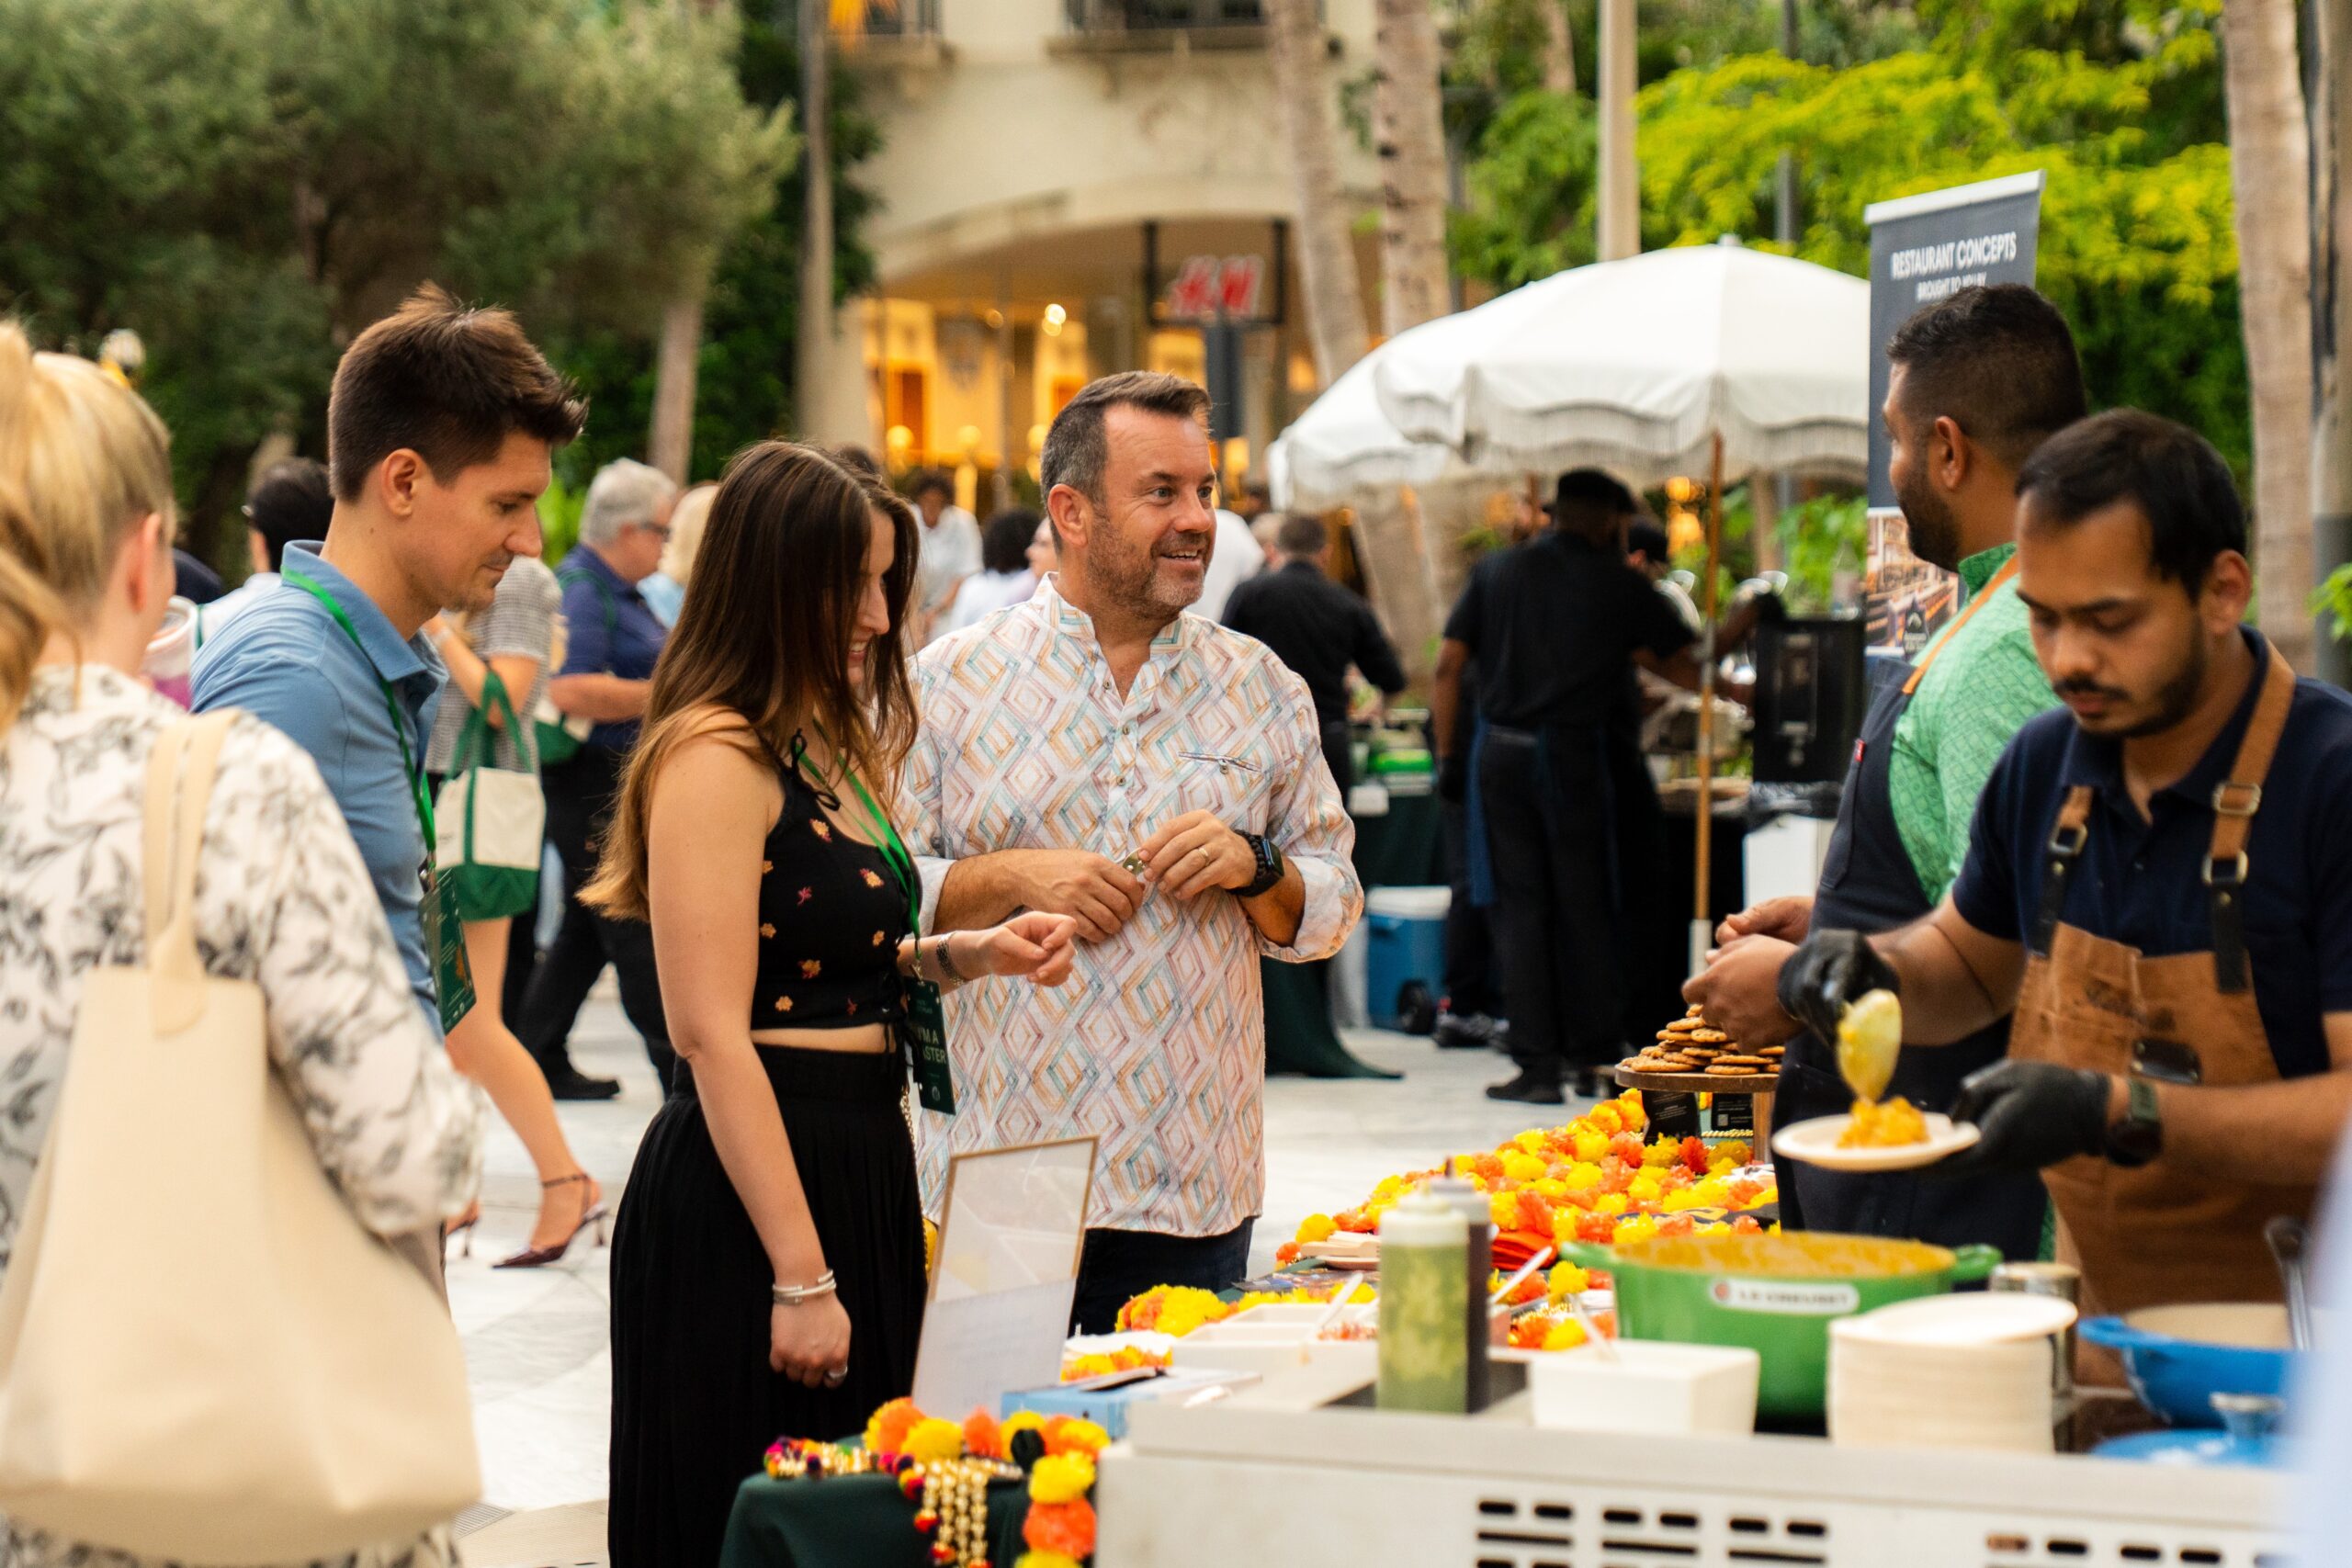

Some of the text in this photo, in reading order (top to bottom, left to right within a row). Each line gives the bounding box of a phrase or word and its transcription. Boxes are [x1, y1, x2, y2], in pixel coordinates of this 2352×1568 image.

[1892, 231, 2017, 279] RESTAURANT CONCEPTS
[1167, 254, 1264, 318] HM
